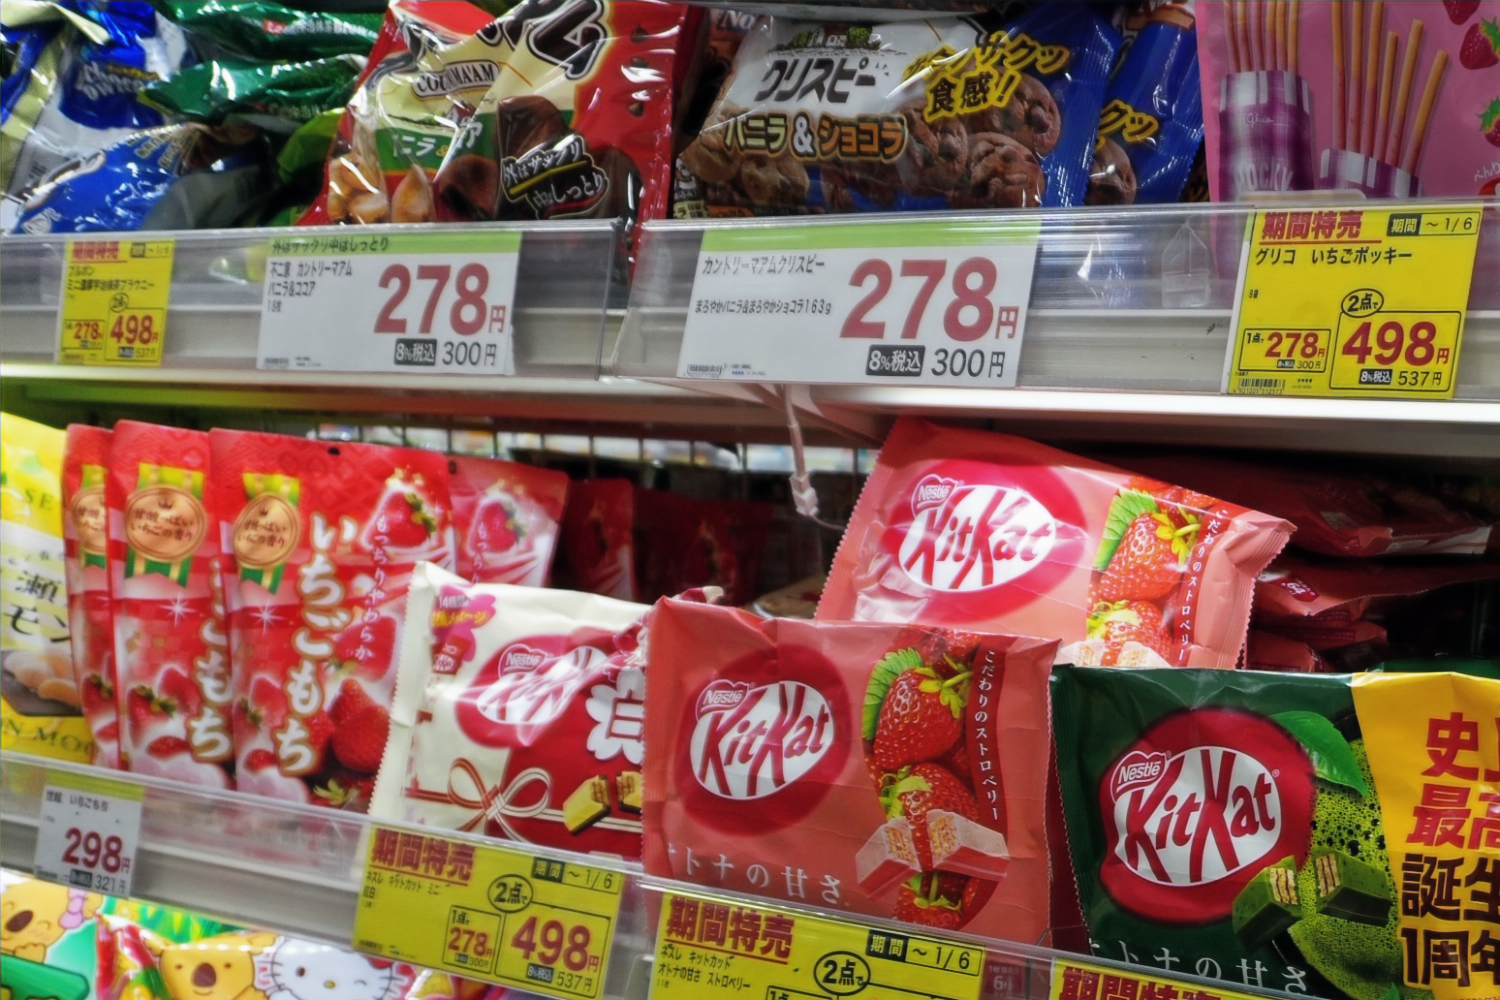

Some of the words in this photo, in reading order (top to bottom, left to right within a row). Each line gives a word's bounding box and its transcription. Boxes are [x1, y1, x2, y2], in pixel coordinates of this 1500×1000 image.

[755, 58, 877, 103] クリスピー
[1261, 211, 1364, 240] 期間特売
[1391, 218, 1418, 233] 期間
[1256, 248, 1297, 266] グリコ
[1311, 247, 1413, 266] いちごポッキー
[1347, 293, 1379, 313] 2点で
[906, 486, 1057, 591] KitKat
[700, 680, 835, 801] KitKat
[1118, 758, 1162, 786] Nestlé
[1124, 747, 1278, 885] KitKat
[820, 957, 866, 989] 2点で
